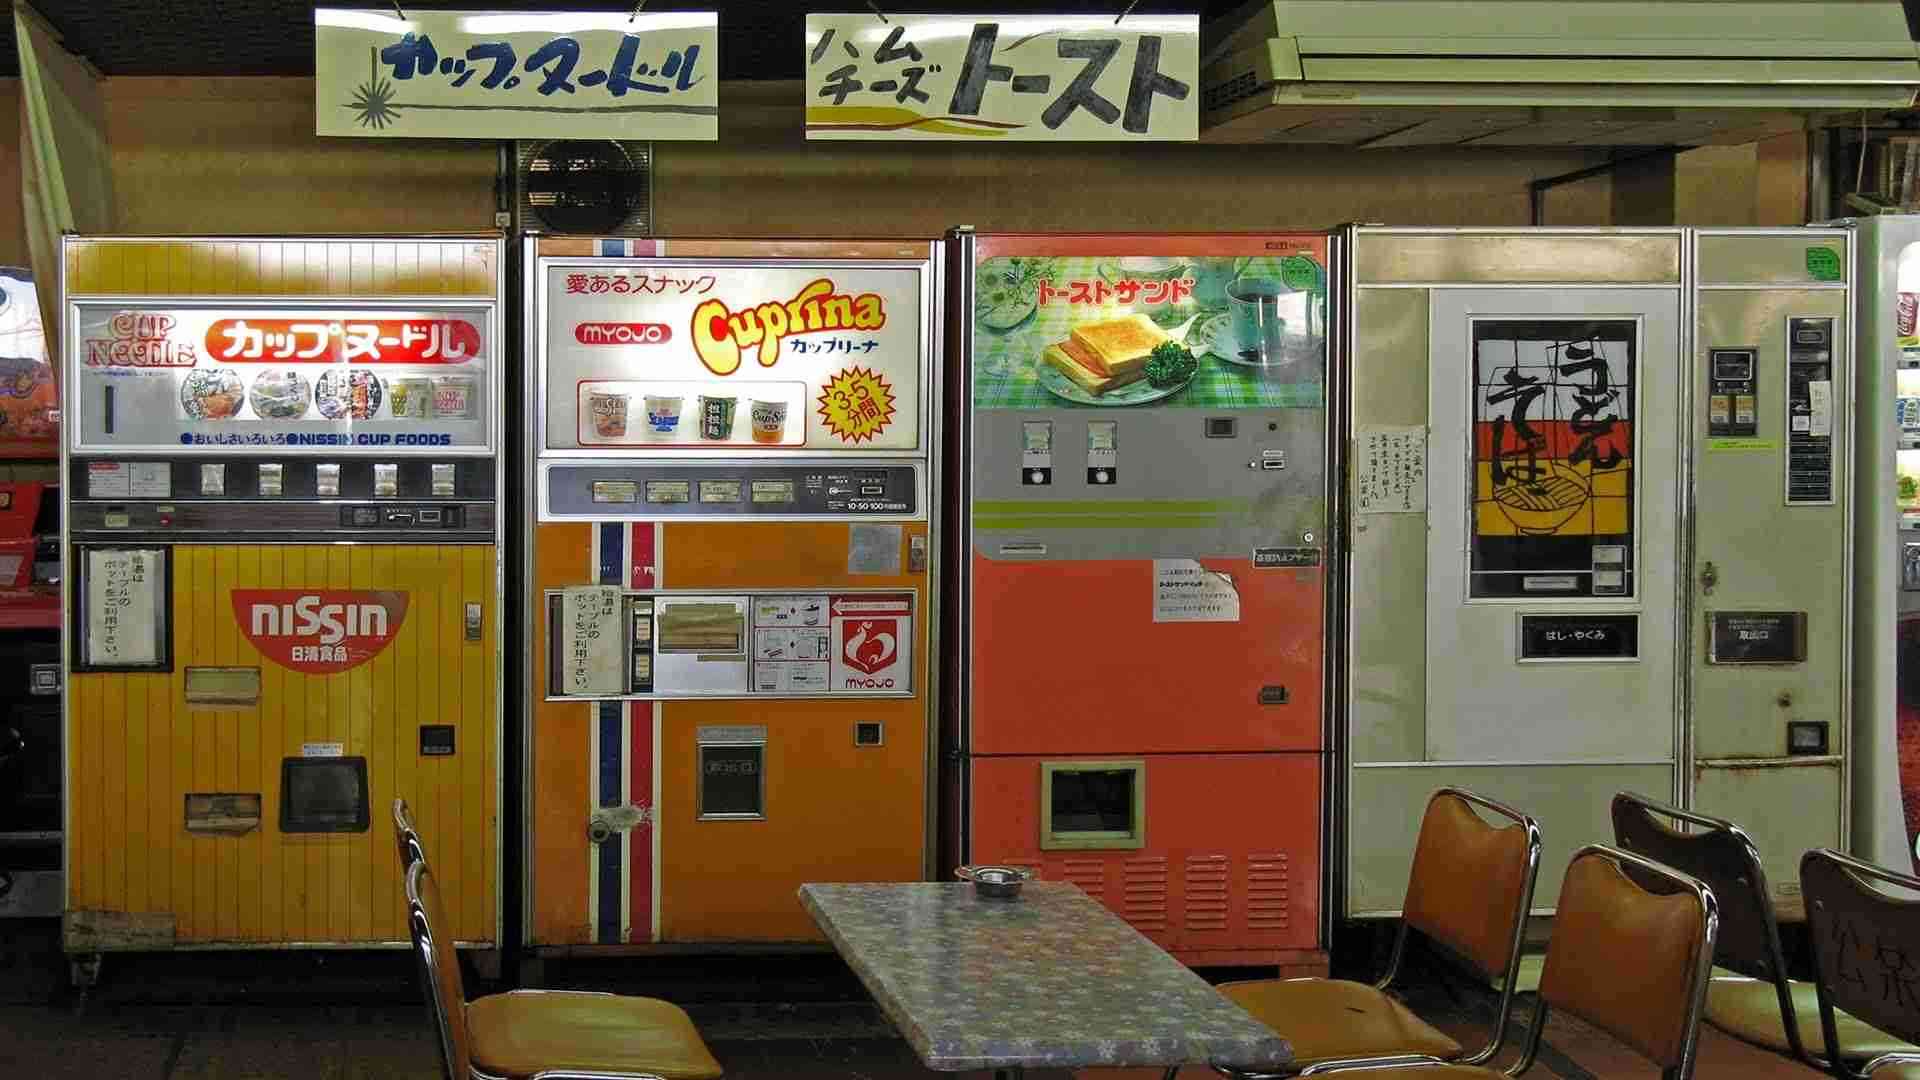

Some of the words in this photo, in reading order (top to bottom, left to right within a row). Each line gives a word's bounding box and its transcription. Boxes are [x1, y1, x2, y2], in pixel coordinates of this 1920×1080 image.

[381, 32, 704, 97] カップヌードル
[810, 26, 923, 65] ハム
[818, 63, 942, 106] チーズ
[948, 23, 1191, 134] トースト
[566, 273, 717, 295] 愛あるスナック
[1039, 279, 1193, 305] トーストサンド
[222, 319, 466, 359] カップヌードル
[584, 325, 662, 342] MYOJO
[691, 278, 887, 376] Cuprina
[790, 337, 879, 354] カップリーナ
[1560, 343, 1624, 469] うどん
[300, 433, 352, 445] NISSIN
[358, 433, 391, 445] CUP
[395, 433, 452, 445] FOODS
[1486, 366, 1548, 496] そば
[588, 593, 601, 640] テーブルの
[291, 645, 347, 662] 日清食品
[845, 678, 895, 689] MYOJO
